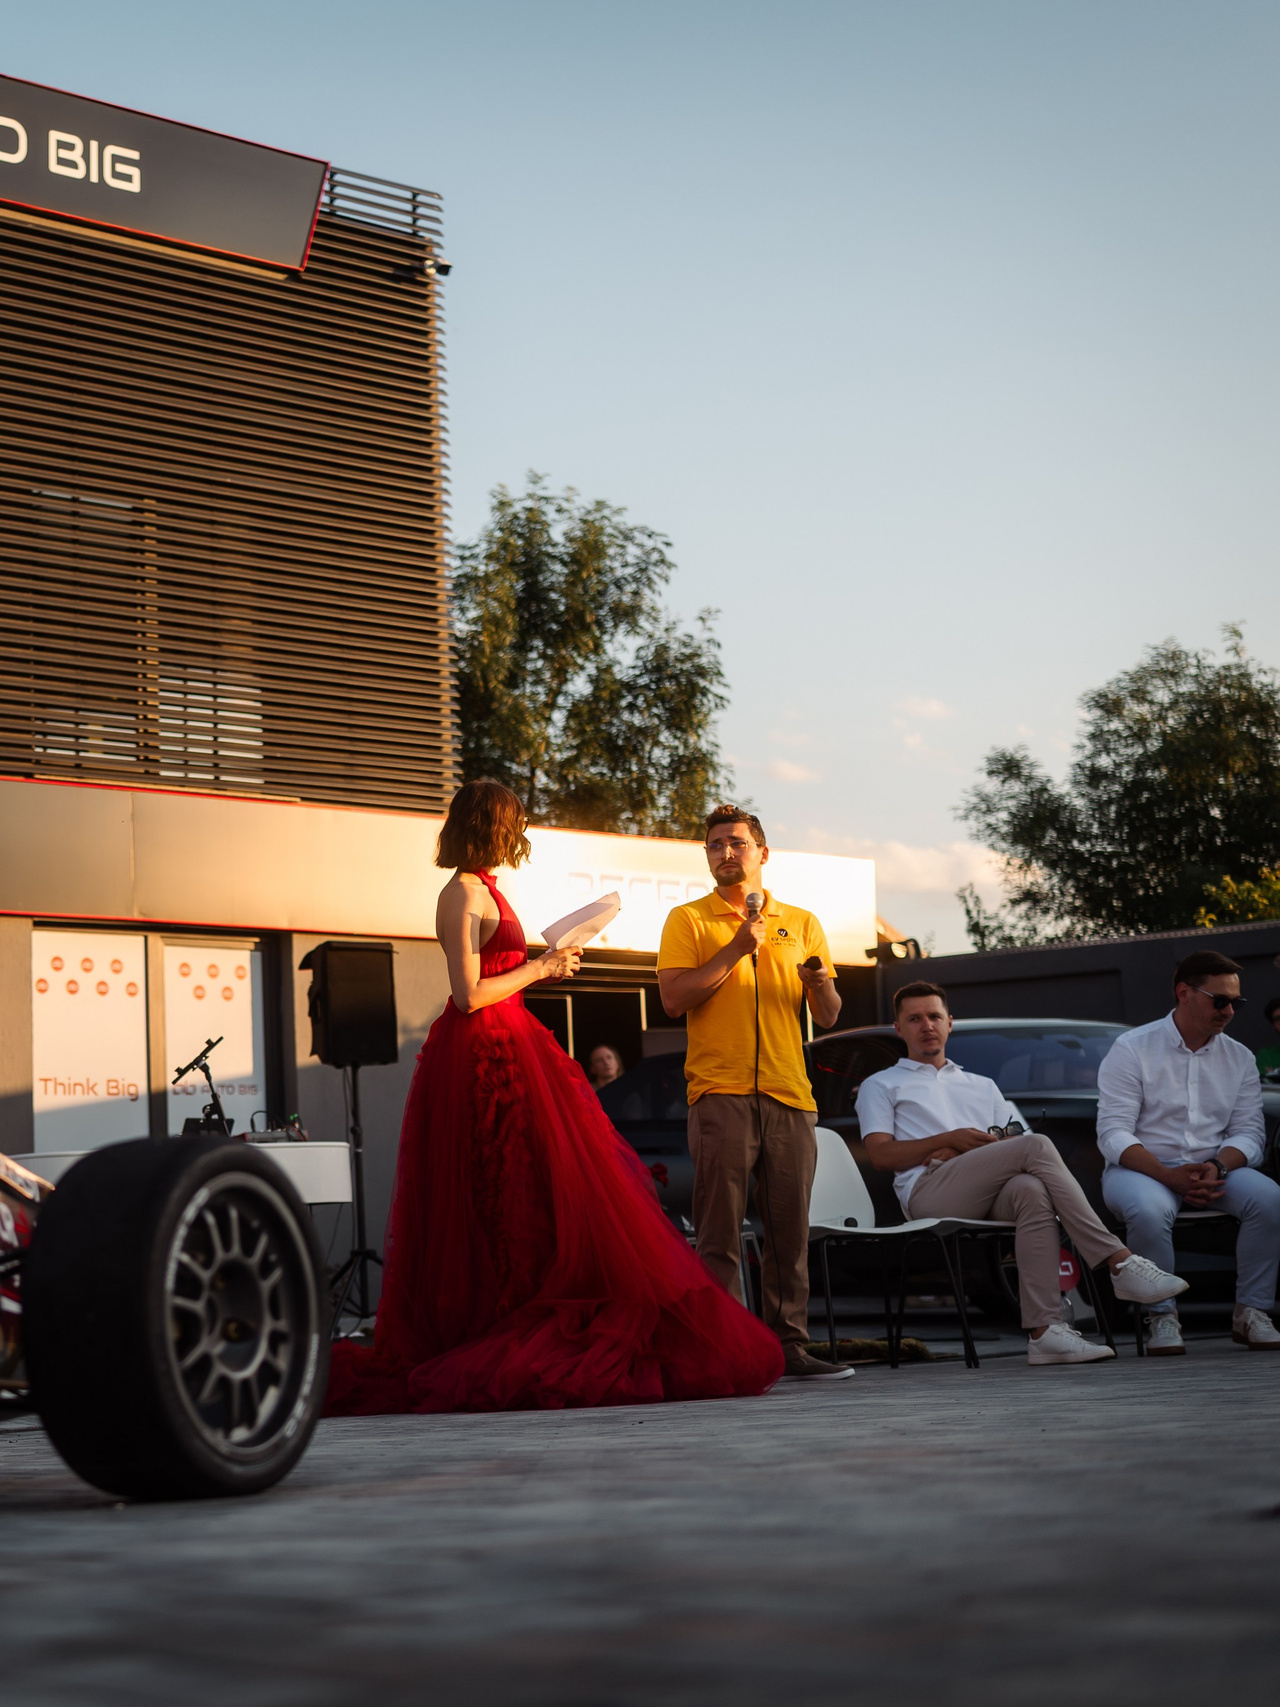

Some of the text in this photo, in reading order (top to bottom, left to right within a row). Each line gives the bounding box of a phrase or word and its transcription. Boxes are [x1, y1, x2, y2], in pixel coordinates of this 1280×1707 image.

[48, 130, 141, 193] BIG
[39, 1077, 139, 1102] Think Big
[201, 1084, 236, 1096] ATO
